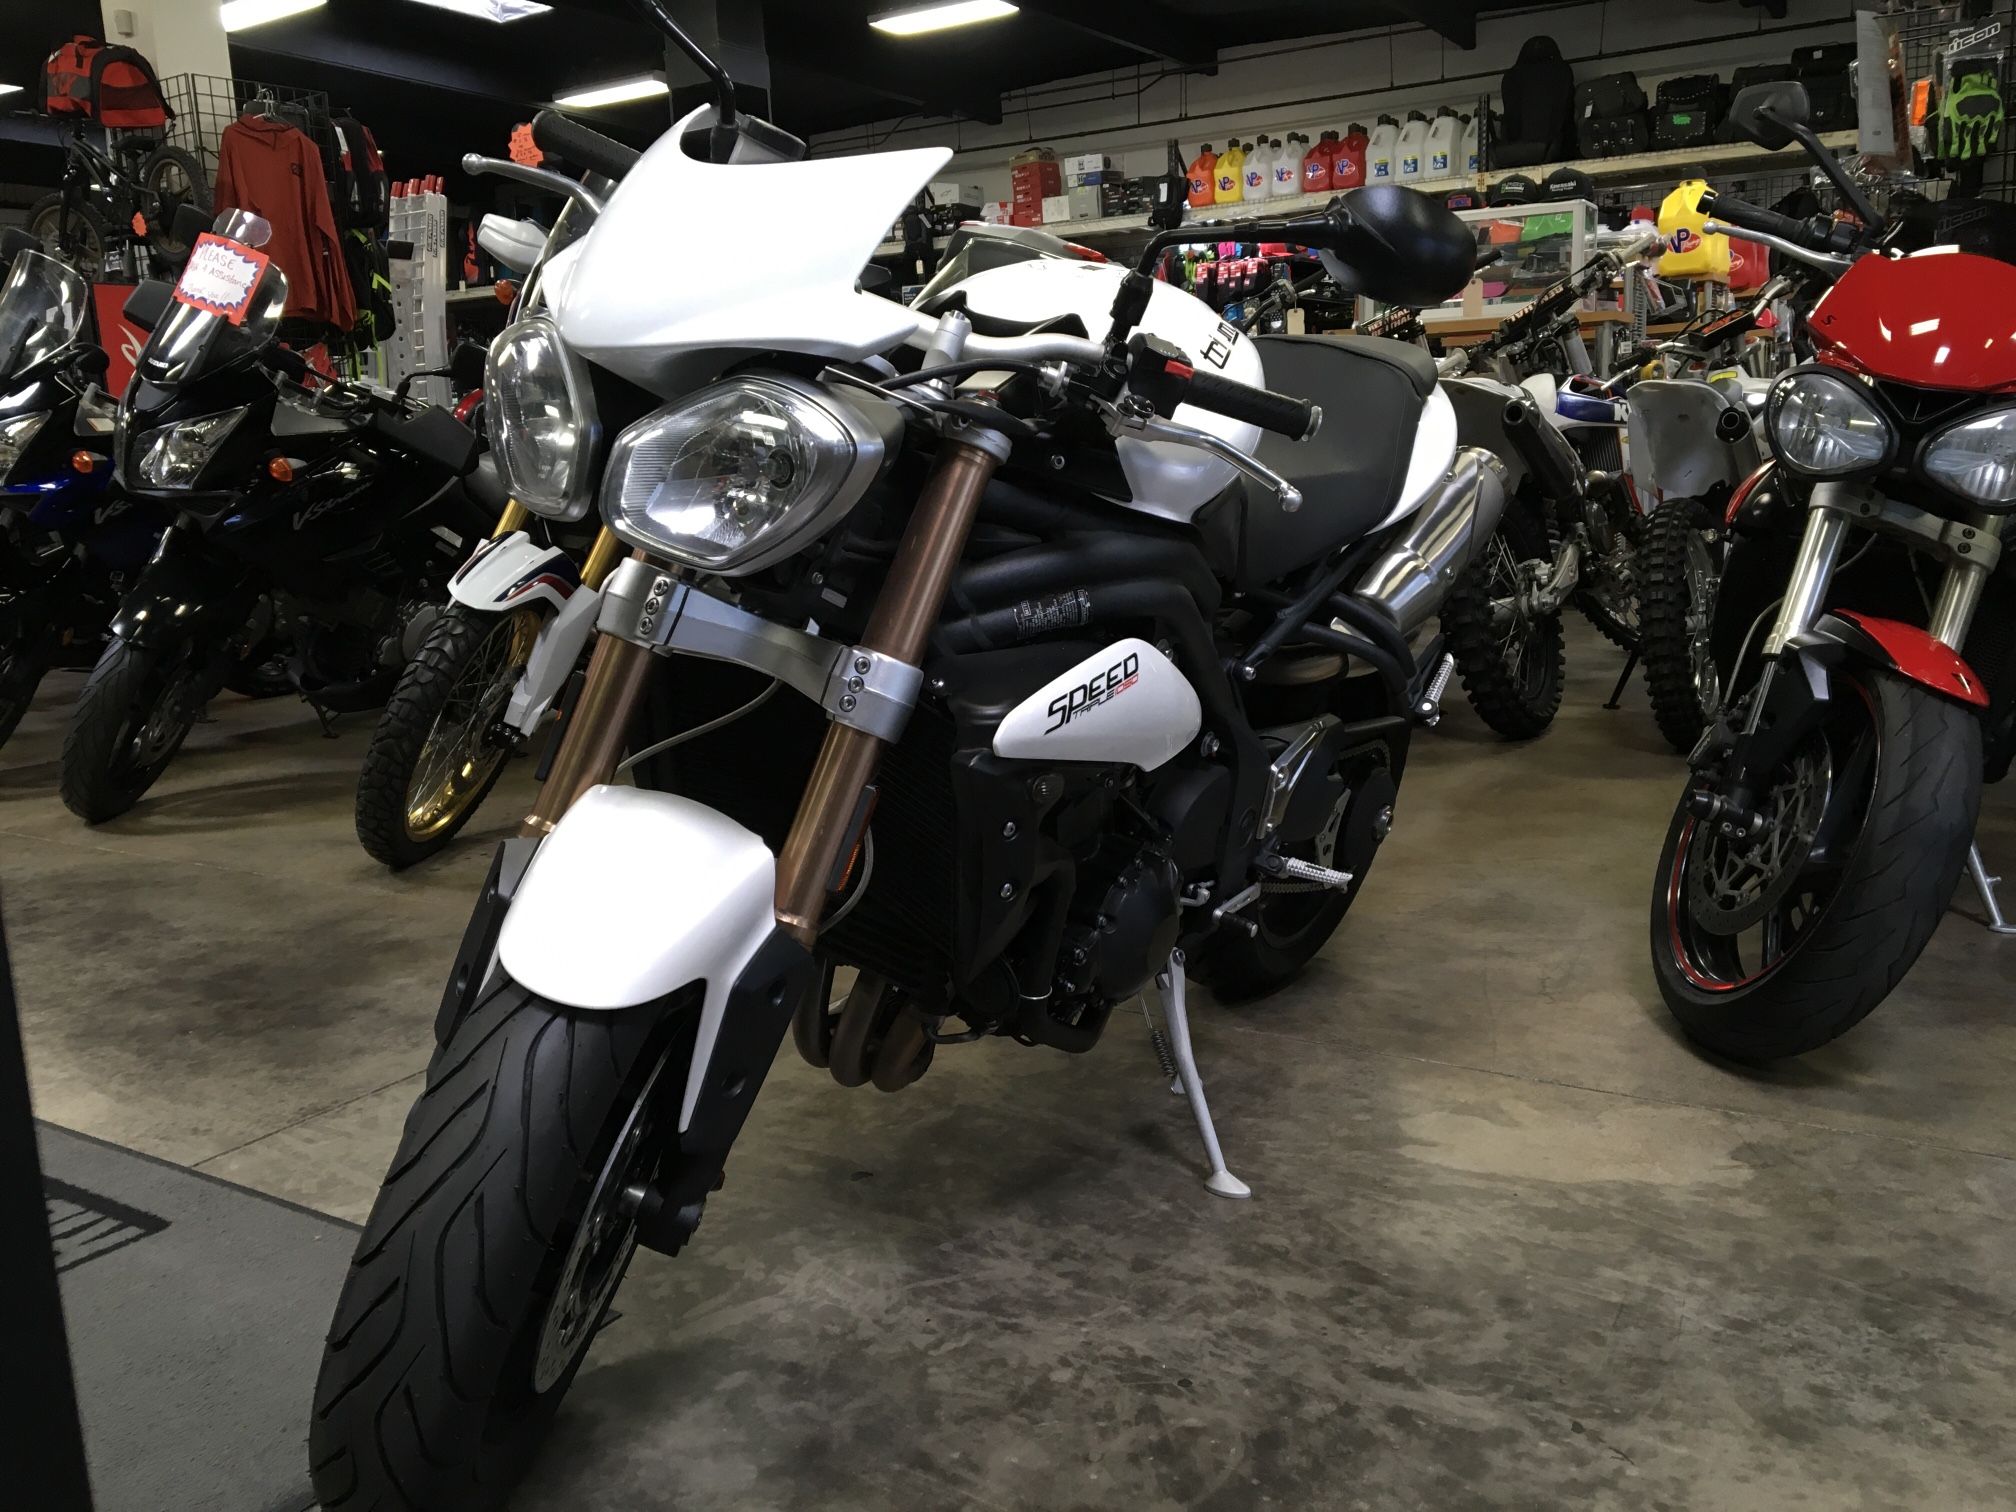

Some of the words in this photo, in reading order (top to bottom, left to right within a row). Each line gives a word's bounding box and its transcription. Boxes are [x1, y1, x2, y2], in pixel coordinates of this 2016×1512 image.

[1670, 228, 1691, 254] VP
[1044, 652, 1139, 736] SPEED
[1073, 689, 1115, 719] TRIPLE
[1115, 673, 1140, 695] 1050
